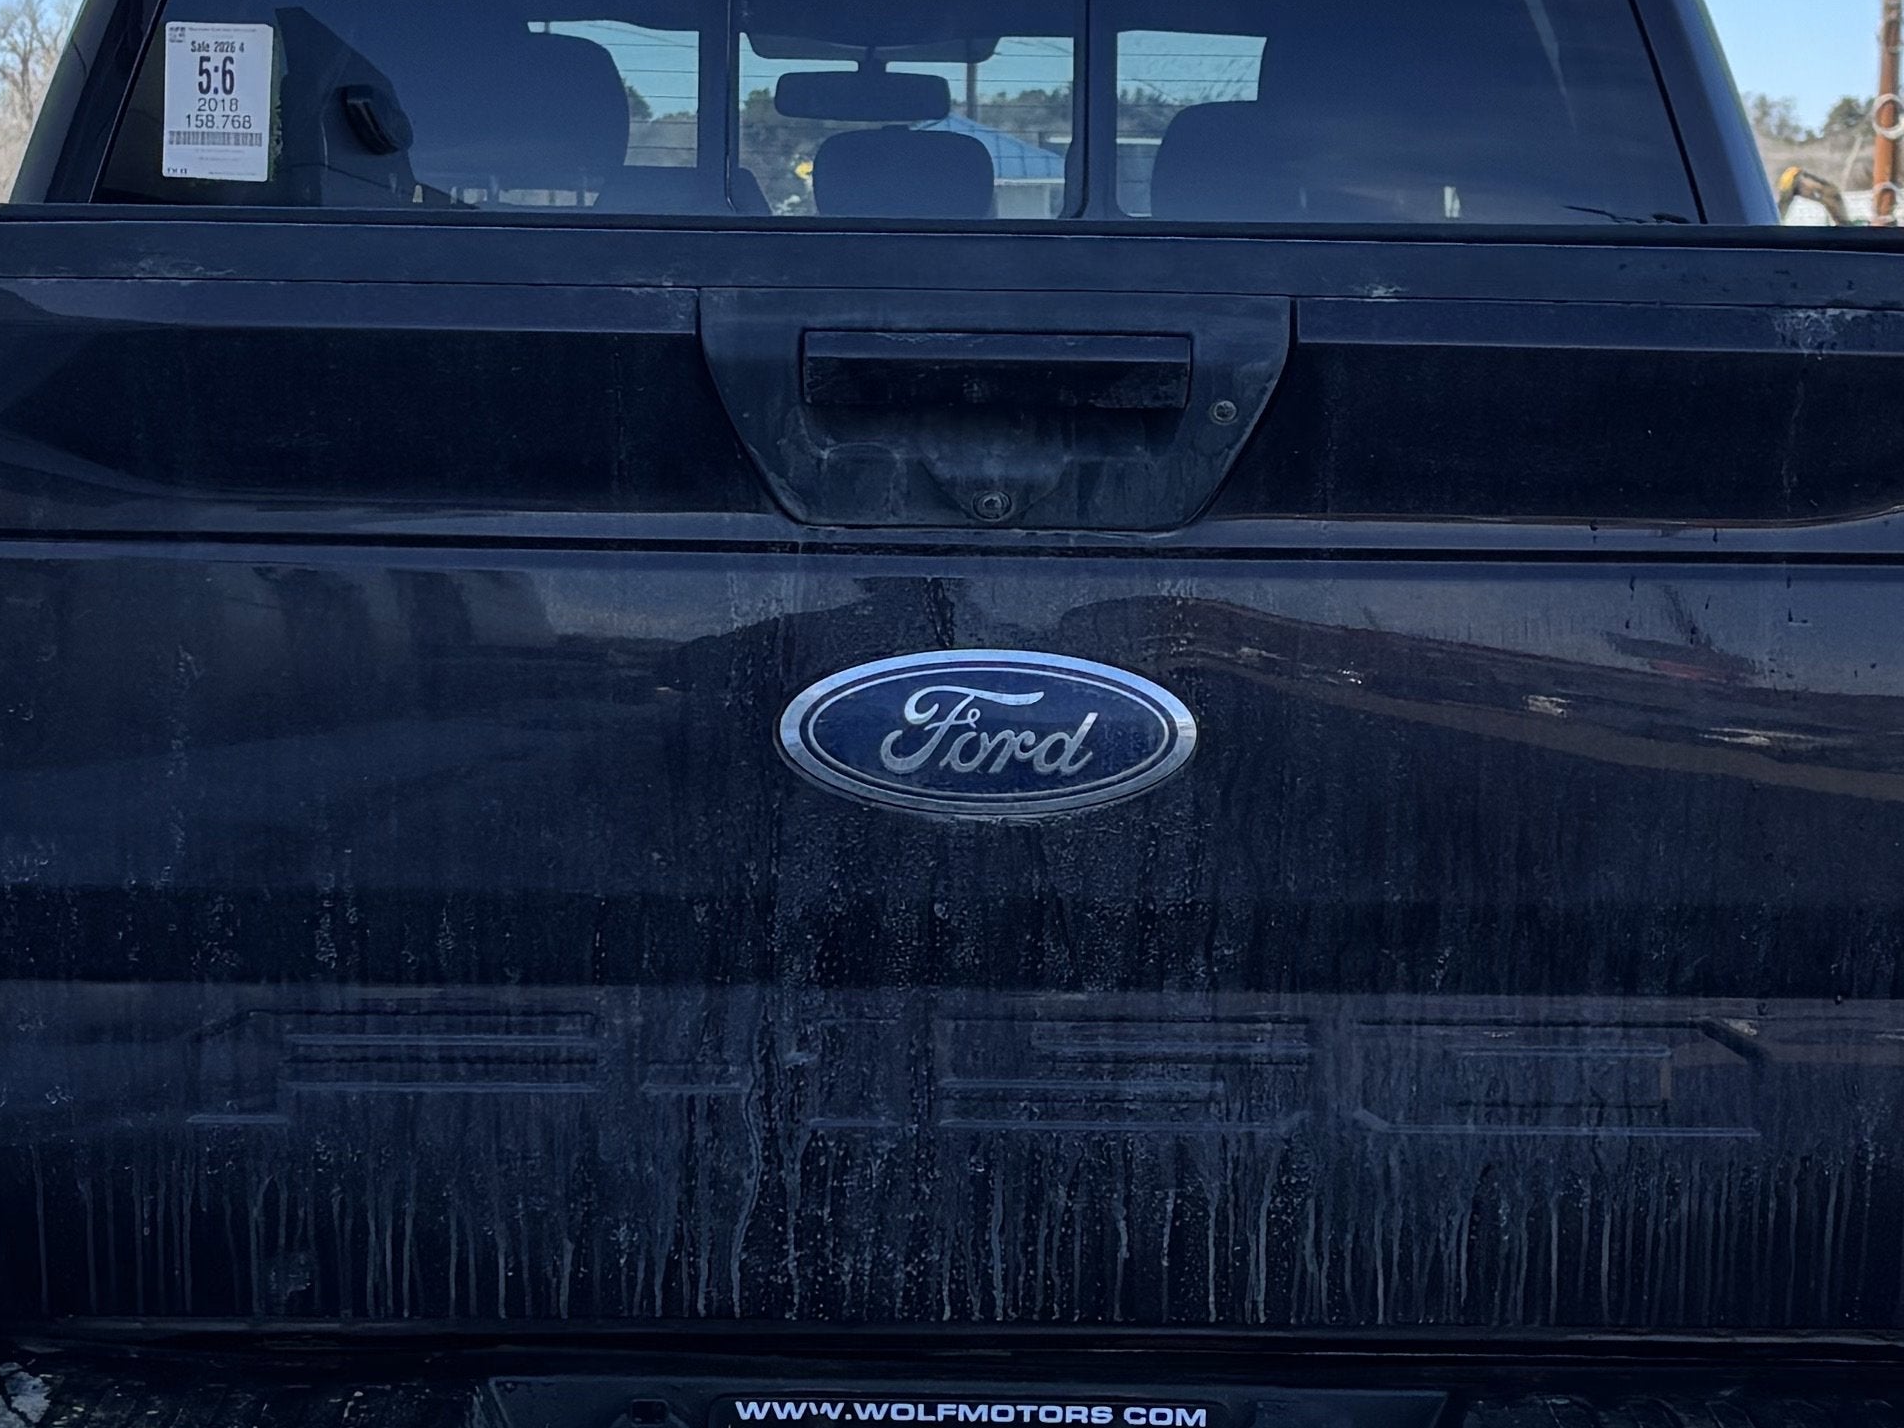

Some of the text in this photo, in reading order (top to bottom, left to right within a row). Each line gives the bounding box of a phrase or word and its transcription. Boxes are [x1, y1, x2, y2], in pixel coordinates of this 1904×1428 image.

[191, 41, 210, 53] Sale
[198, 56, 235, 95] 5:6
[197, 98, 239, 112] 2018
[879, 685, 1099, 775] Ford
